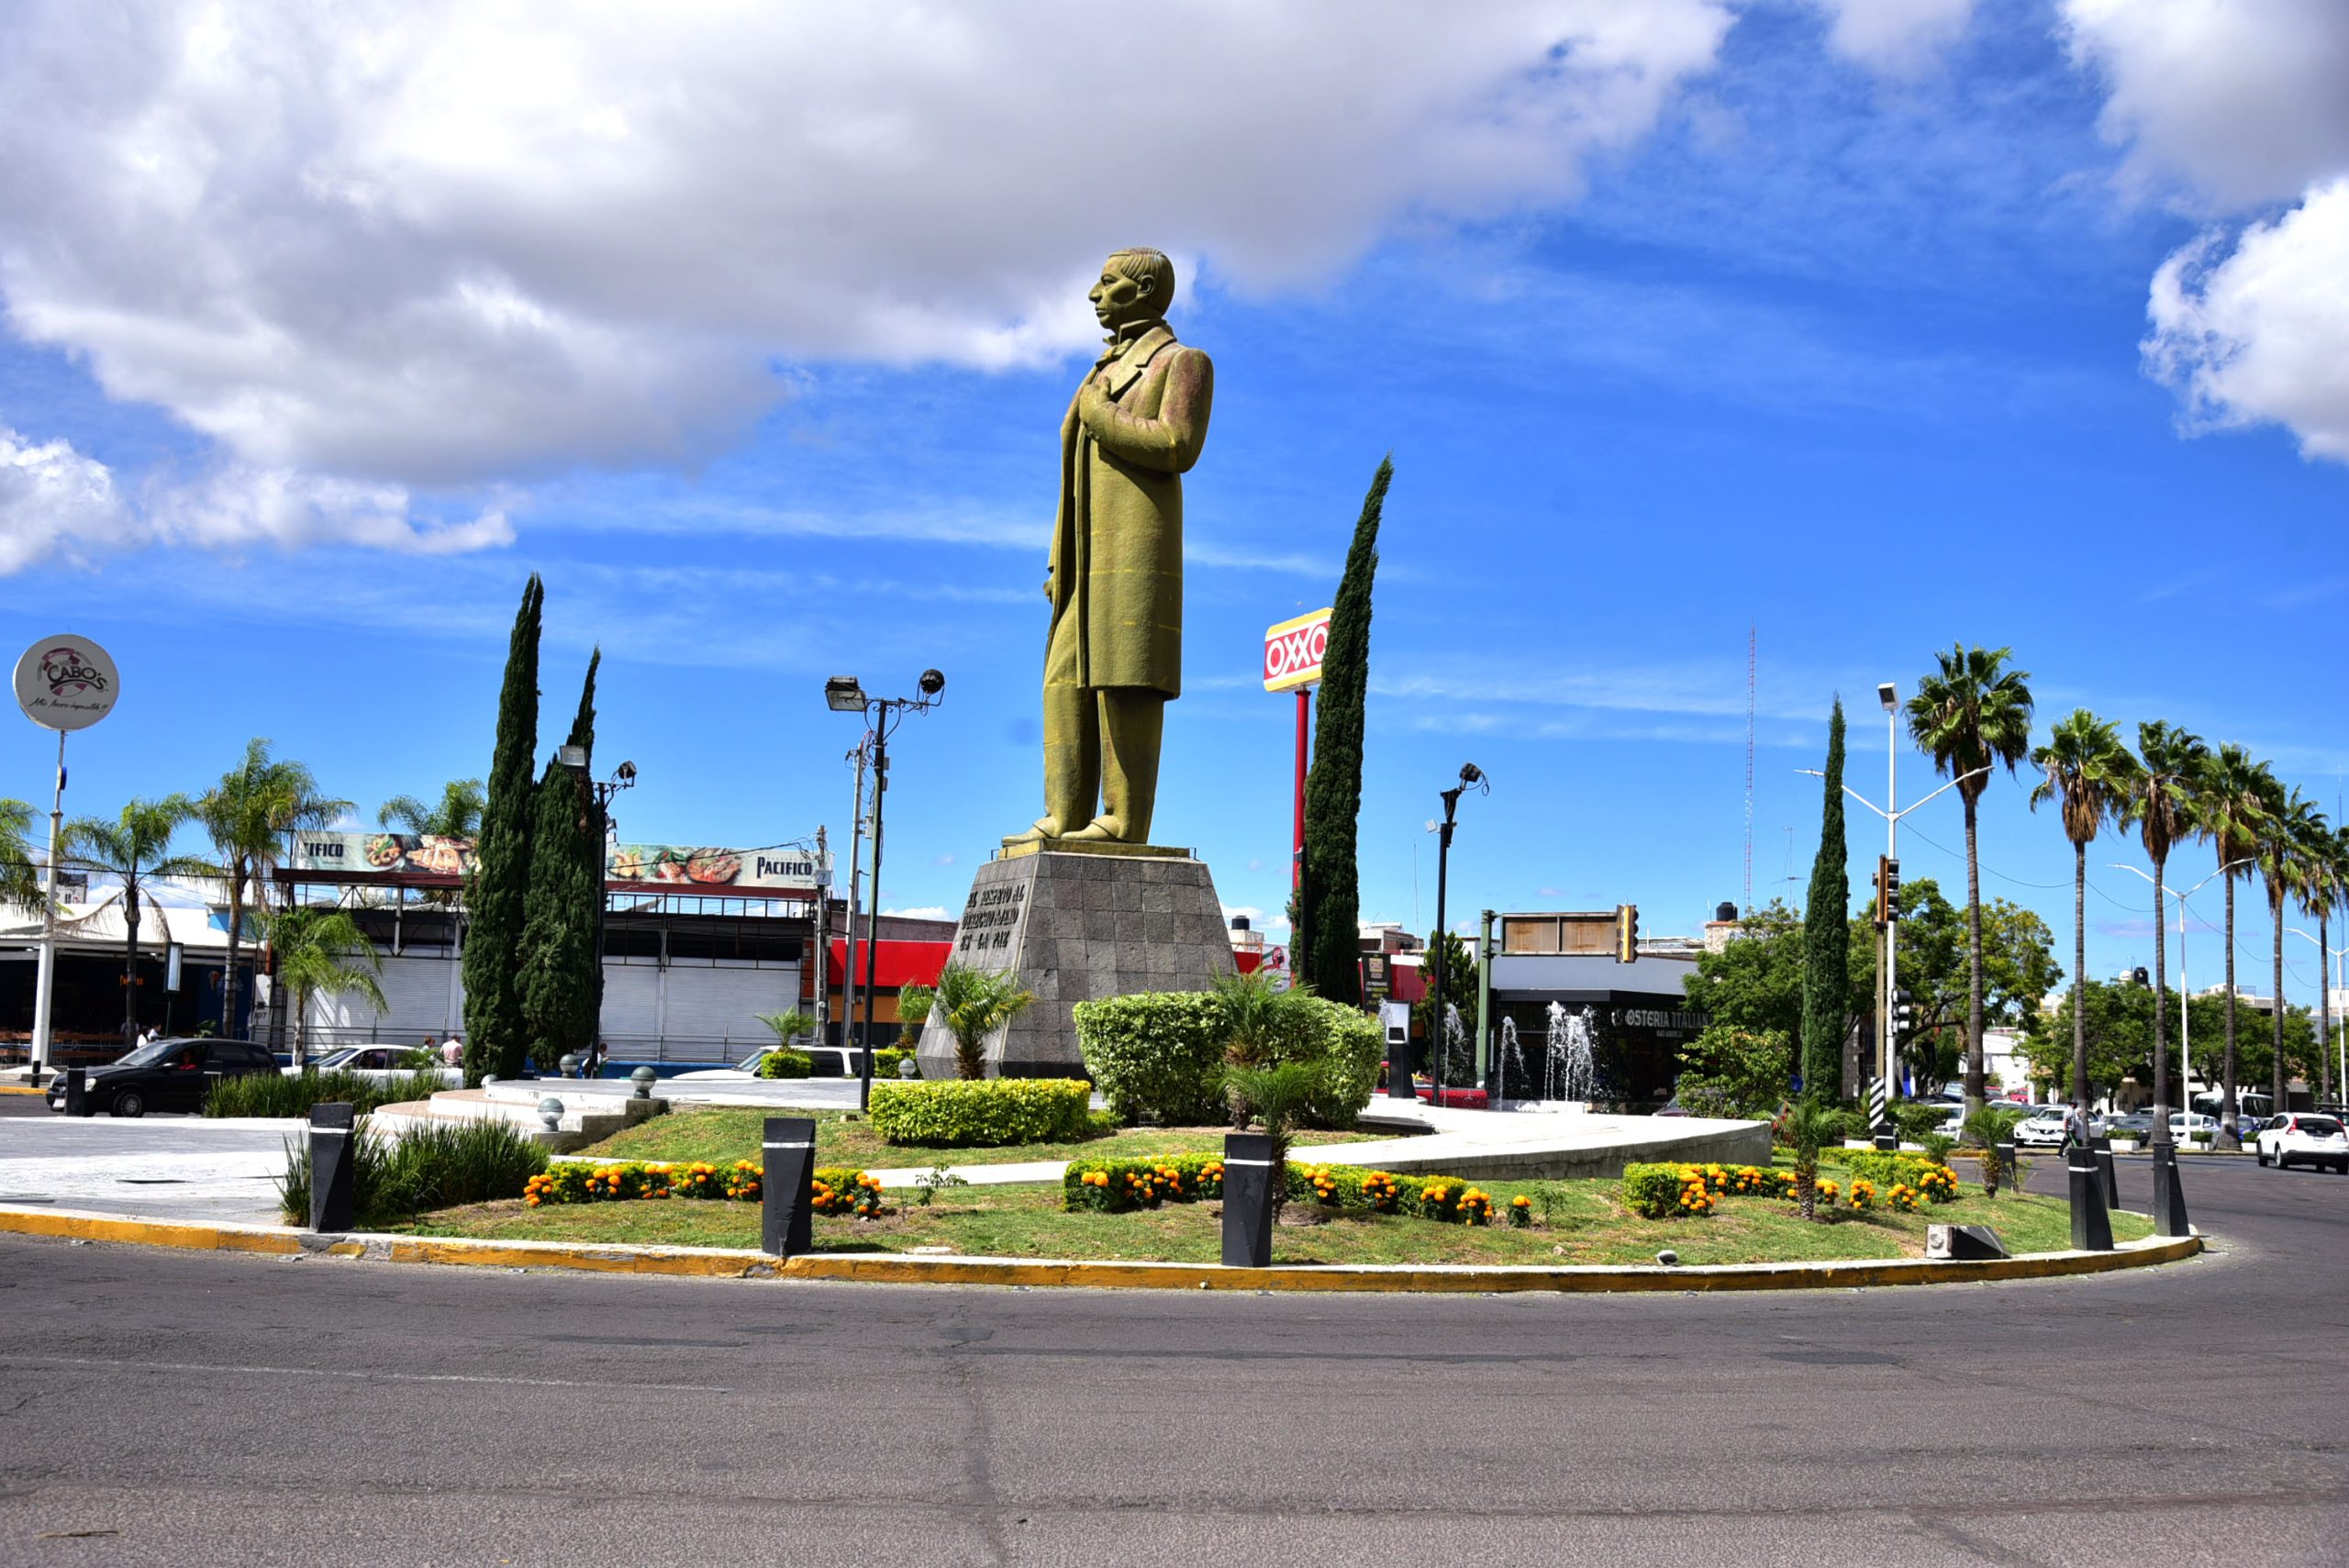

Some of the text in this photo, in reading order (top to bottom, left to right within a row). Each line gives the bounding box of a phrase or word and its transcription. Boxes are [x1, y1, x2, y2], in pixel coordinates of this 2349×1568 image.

[1266, 626, 1329, 676] OXXO
[757, 856, 813, 879] PACIFICO
[967, 884, 1025, 907] EL RESPETO AL
[962, 906, 1019, 929] DERECHO AJENO
[960, 930, 1010, 951] ES LA PAZ
[1627, 1009, 1670, 1027] OSTERIA
